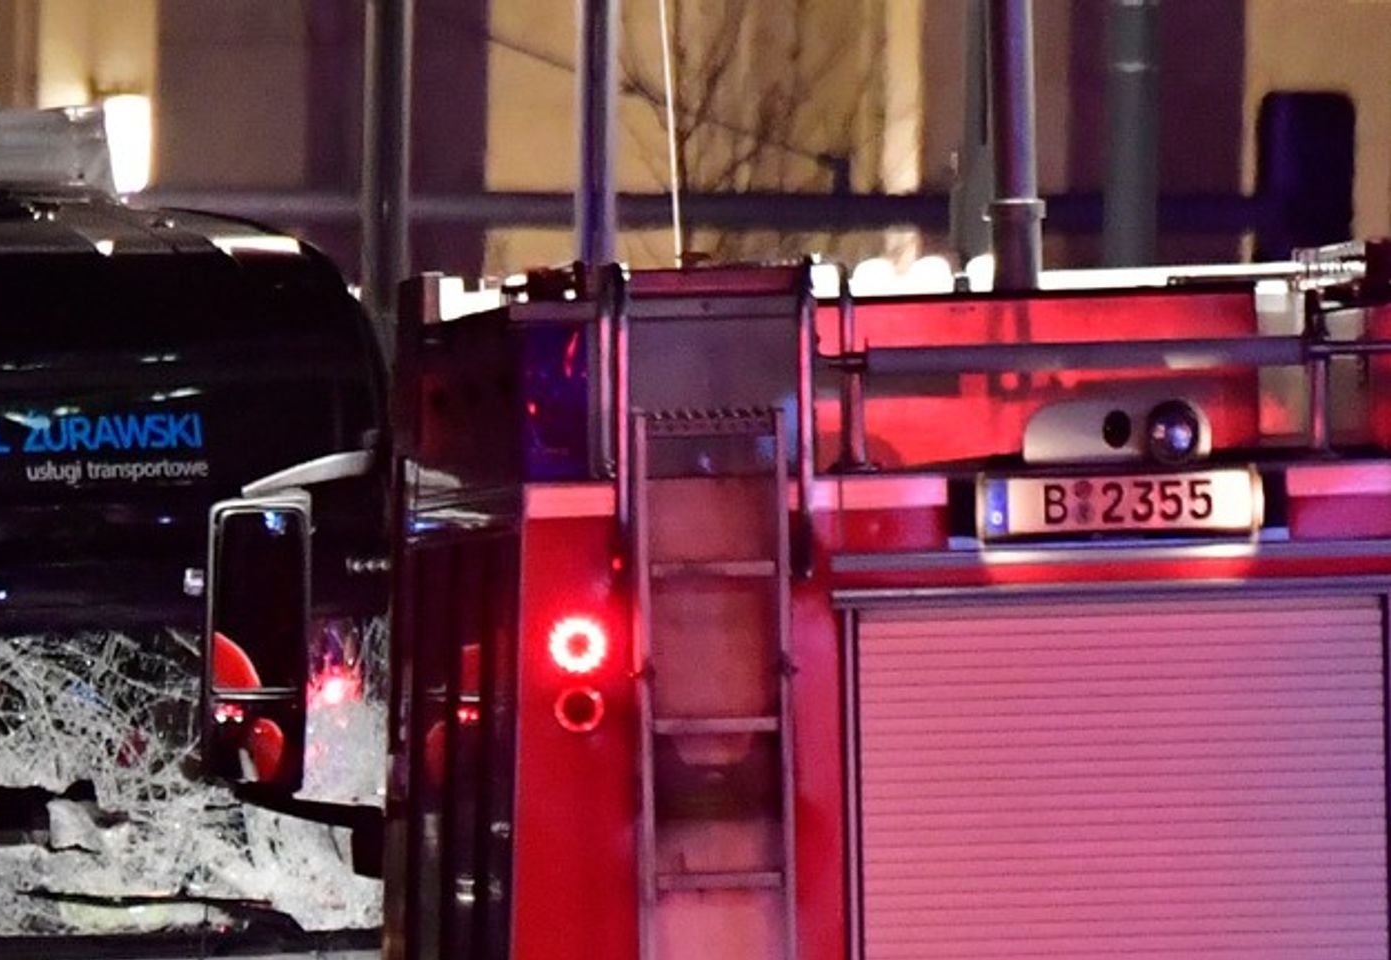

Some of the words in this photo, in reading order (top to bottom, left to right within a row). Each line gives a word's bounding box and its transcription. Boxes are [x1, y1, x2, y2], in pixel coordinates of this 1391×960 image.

[87, 458, 210, 483] transportowe
[1043, 483, 1069, 526] B
[1101, 479, 1214, 525] 2355
